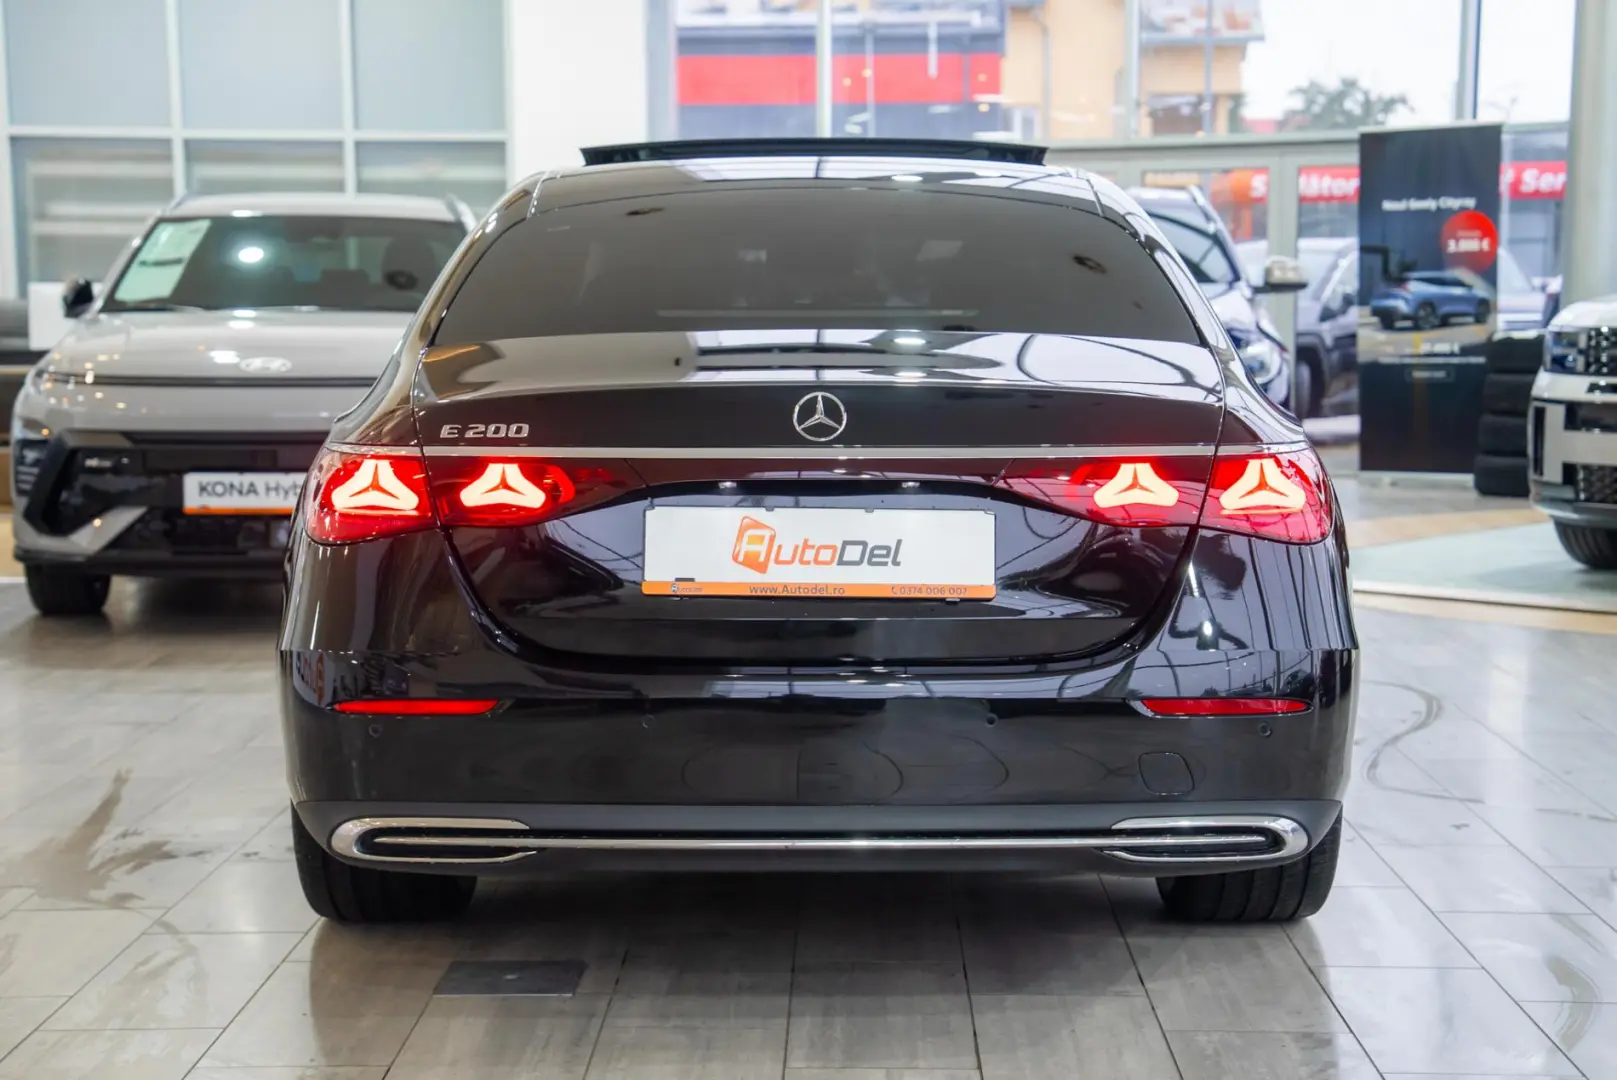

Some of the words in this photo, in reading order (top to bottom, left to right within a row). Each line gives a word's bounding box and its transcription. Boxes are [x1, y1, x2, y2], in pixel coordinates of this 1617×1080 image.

[440, 424, 462, 438] E
[464, 423, 530, 438] 200
[198, 480, 259, 497] KONA
[736, 524, 903, 568] AutoDel
[749, 583, 846, 596] www.Autodel.ro
[899, 585, 923, 596] 0374
